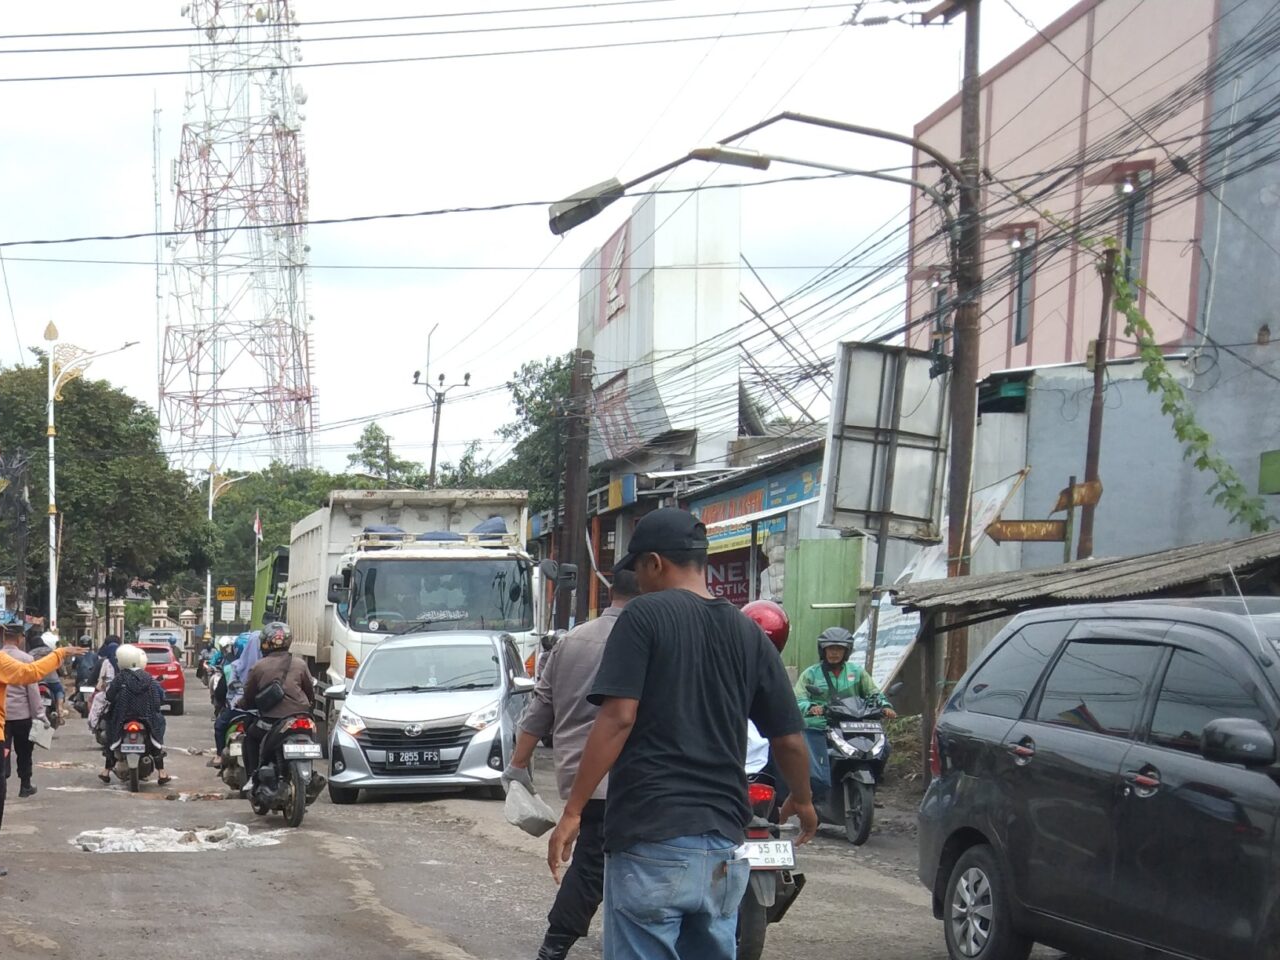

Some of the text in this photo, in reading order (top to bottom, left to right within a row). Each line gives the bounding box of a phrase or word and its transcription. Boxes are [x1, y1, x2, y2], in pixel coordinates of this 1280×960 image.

[388, 752, 395, 762] B
[424, 751, 438, 761] FFS
[776, 843, 790, 854] RX
